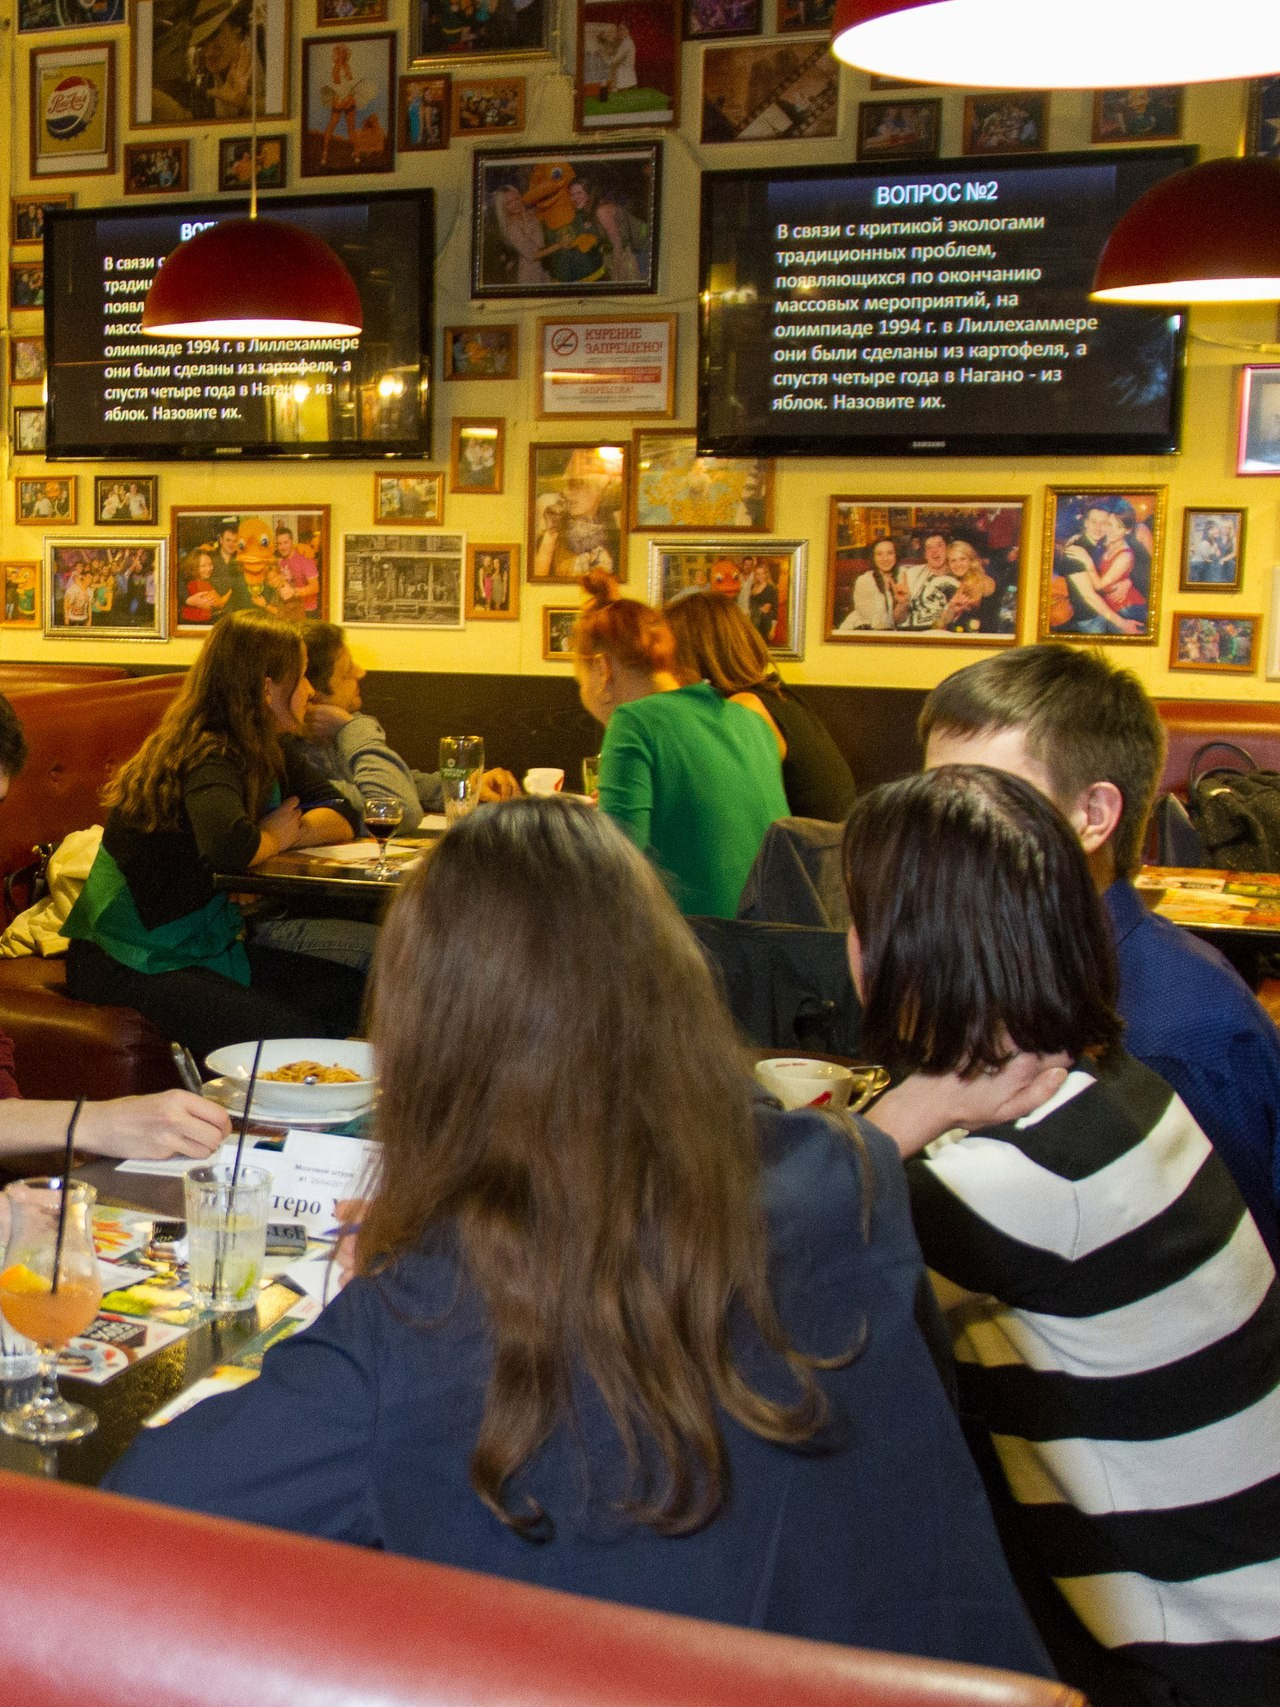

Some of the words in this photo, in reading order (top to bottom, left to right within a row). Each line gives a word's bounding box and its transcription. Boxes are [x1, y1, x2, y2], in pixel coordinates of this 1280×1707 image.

[877, 183, 961, 205] ВОПРОС
[966, 181, 998, 201] №2
[778, 224, 787, 239] В
[793, 224, 840, 238] связи
[845, 225, 855, 236] с
[860, 217, 943, 237] критикой
[948, 214, 1045, 235] экологами
[105, 258, 114, 271] В
[116, 256, 154, 270] связи
[777, 246, 905, 266] традиционных
[911, 242, 997, 261] проблем,
[104, 279, 152, 294] традиц
[776, 271, 905, 290] появляющихся
[911, 270, 932, 285] по
[938, 267, 1041, 284] окончанию
[775, 297, 859, 313] массовых
[864, 292, 991, 313] мероприятий,
[997, 293, 1018, 307] на
[585, 328, 641, 340] КУРЕНИЕ
[775, 322, 873, 339] олимпиаде
[879, 320, 921, 335] 1994
[927, 320, 937, 335] г.
[943, 320, 953, 333] в
[957, 316, 1098, 335] Лиллехаммере
[105, 342, 182, 358] олимпиаде
[186, 339, 220, 355] 1994
[223, 340, 232, 353] г.
[237, 342, 245, 352] в
[249, 336, 359, 353] Лиллехаммере
[585, 342, 663, 354] ЗАПРЕЩЕНО!
[774, 348, 806, 362] они
[812, 343, 856, 360] были
[862, 346, 937, 361] сделаны
[943, 345, 964, 358] из
[969, 340, 1069, 361] картофеля,
[1075, 344, 1087, 356] а
[105, 366, 130, 379] они
[134, 362, 170, 378] были
[174, 364, 234, 377] сделаны
[238, 363, 255, 375] из
[259, 359, 338, 377] картофеля,
[342, 361, 351, 372] а
[773, 371, 828, 390] спустя
[833, 370, 895, 387] четыре
[900, 370, 939, 385] года
[945, 370, 954, 383] в
[960, 367, 1023, 383] Нагано
[1041, 368, 1062, 382] из
[105, 387, 148, 403] спустя
[151, 385, 201, 400] четыре
[205, 384, 236, 399] года
[240, 384, 248, 396] в
[315, 383, 332, 395] из
[773, 393, 828, 411] яблок.
[834, 393, 914, 410] Назовите
[921, 395, 946, 408] их.
[105, 407, 149, 423] яблок.
[153, 406, 217, 421] Назовите
[221, 407, 242, 419] их.
[272, 1194, 321, 1217] теро
